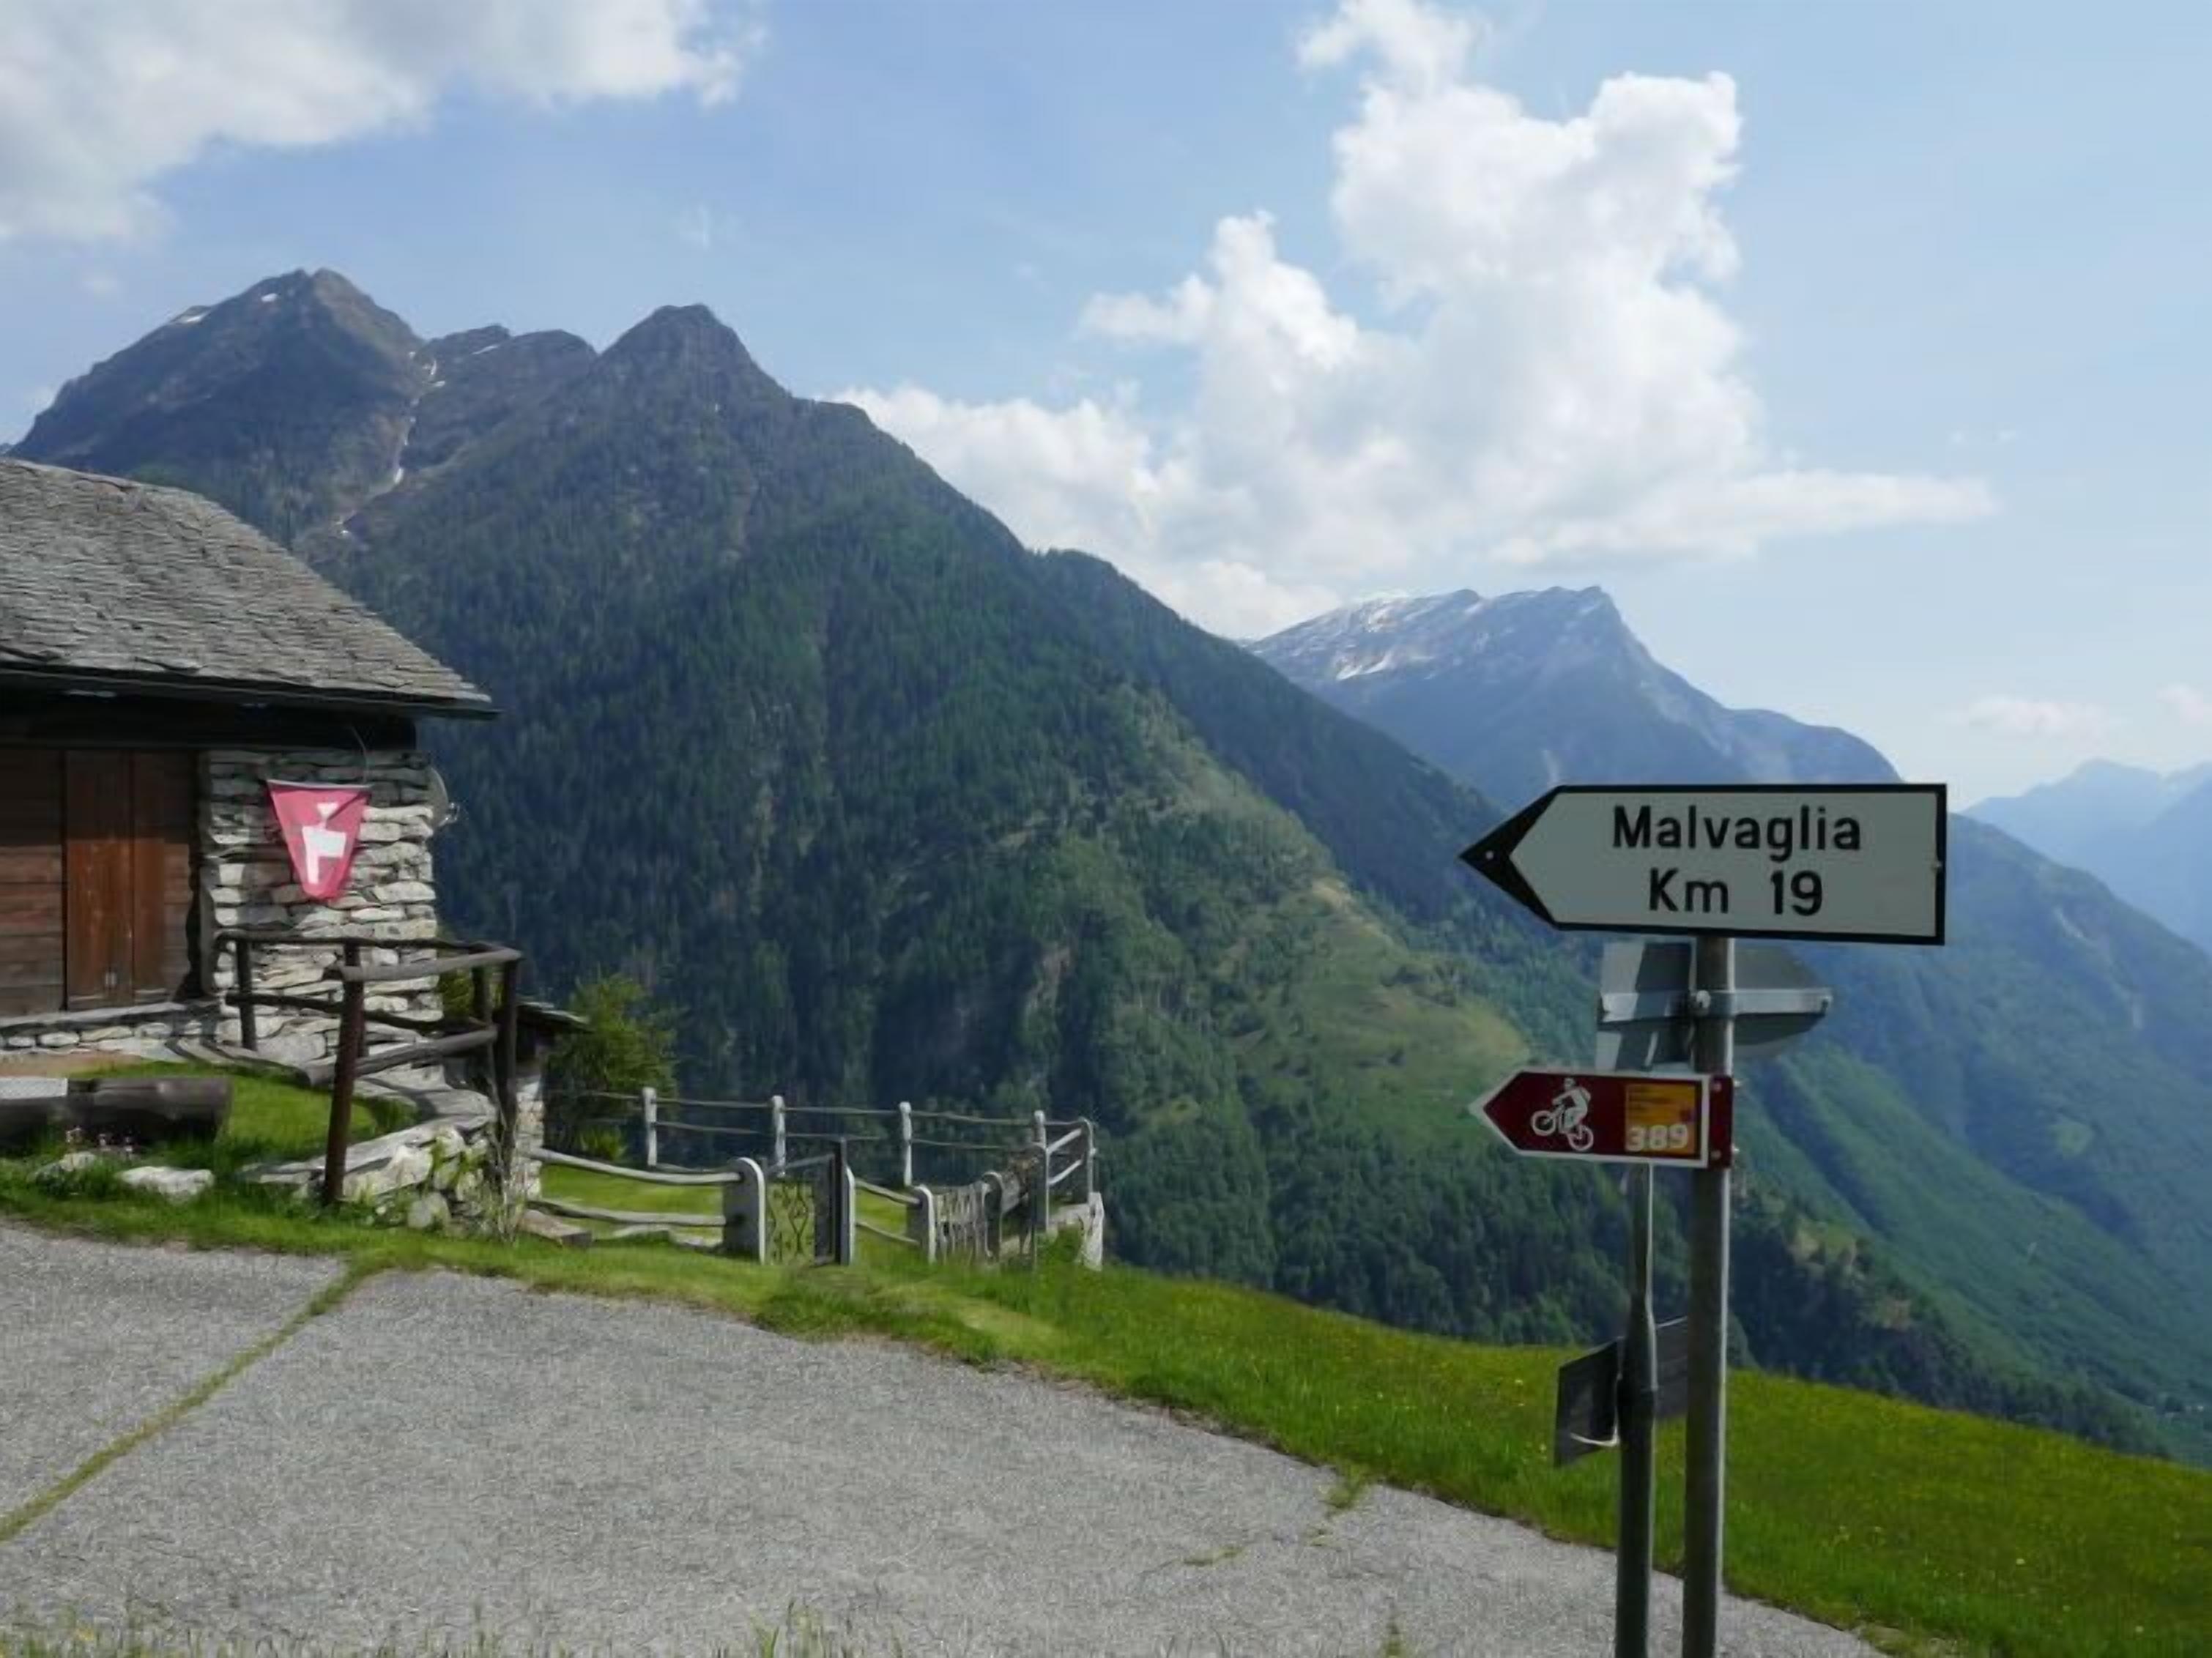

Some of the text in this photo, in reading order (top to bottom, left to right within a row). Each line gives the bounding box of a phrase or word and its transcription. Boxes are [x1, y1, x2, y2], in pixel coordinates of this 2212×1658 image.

[1613, 804, 1860, 863] Malvaglia
[1649, 867, 1823, 916] Km 19
[1625, 1123, 1688, 1151] 389
